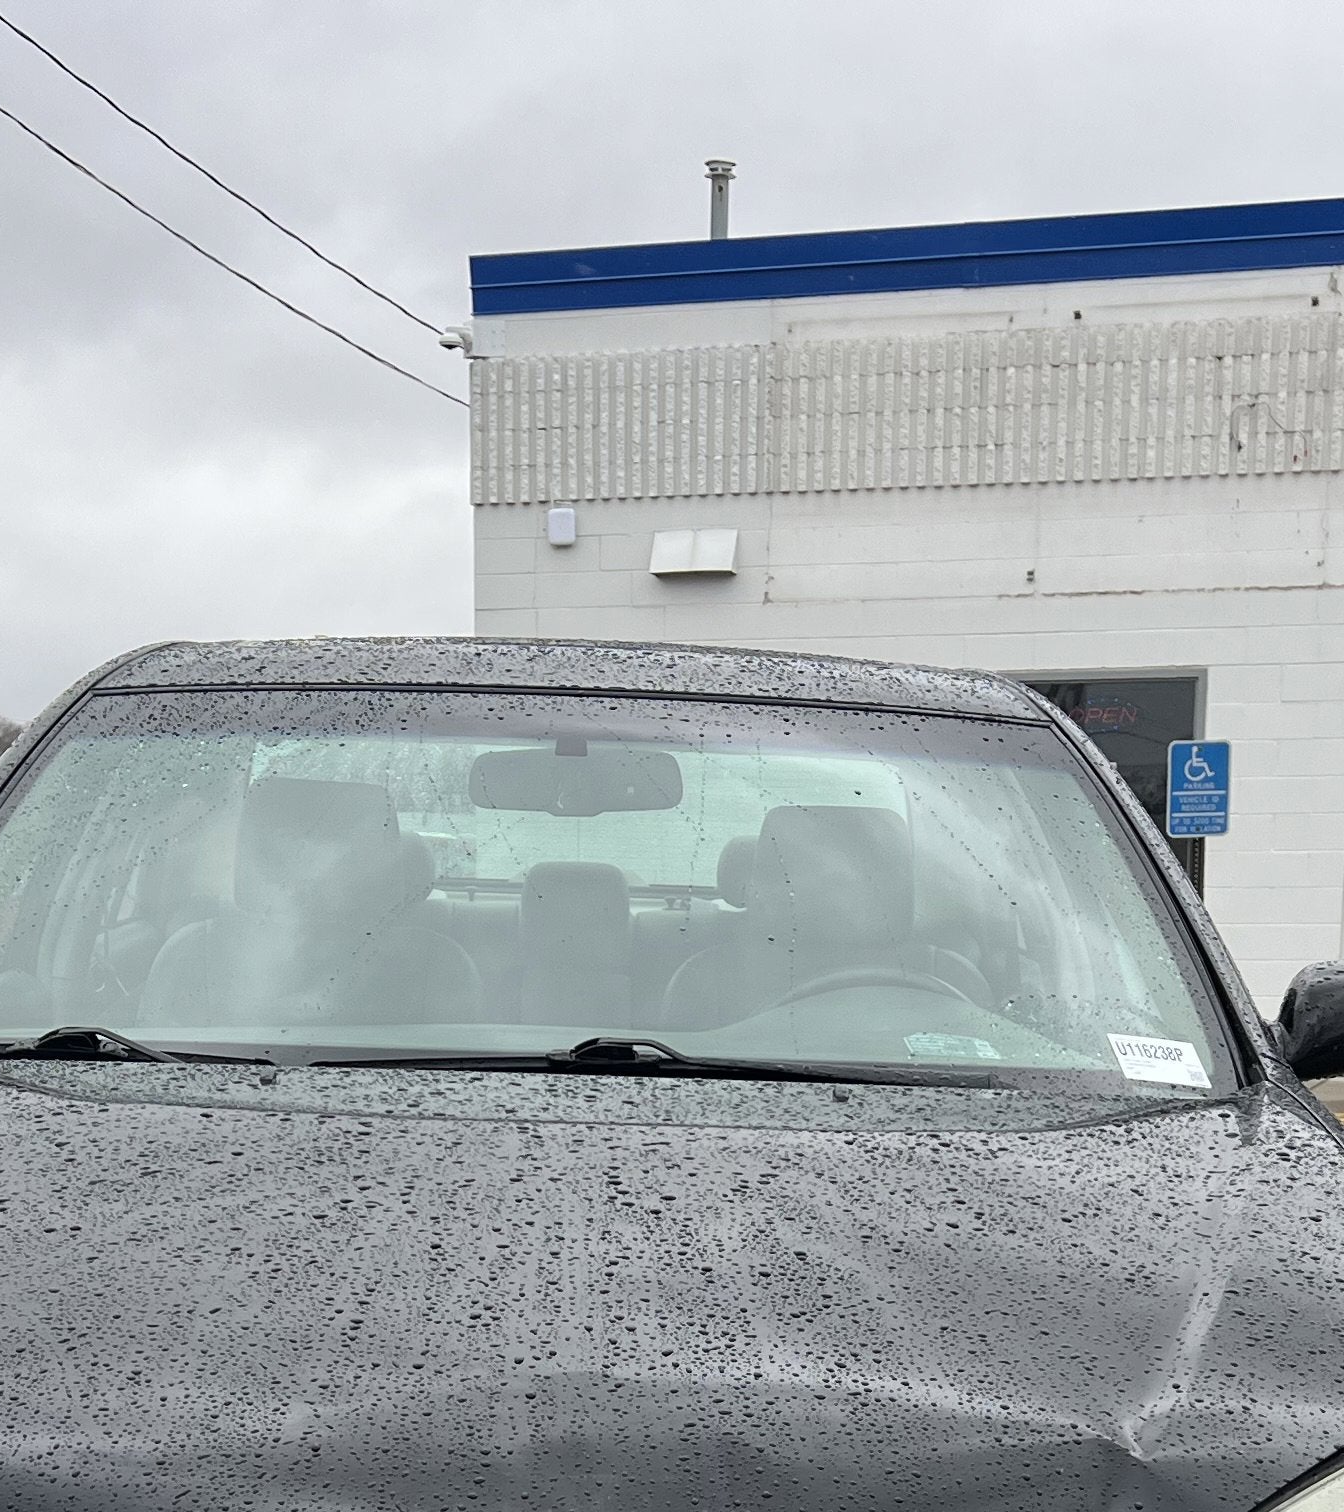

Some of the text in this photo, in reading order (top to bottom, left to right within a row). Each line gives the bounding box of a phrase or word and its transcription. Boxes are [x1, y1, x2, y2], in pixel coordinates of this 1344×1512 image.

[1067, 706, 1137, 725] OPEN
[1183, 782, 1216, 790] PARKING
[1189, 825, 1222, 833] VILATION
[1114, 1040, 1184, 1063] U116238P
